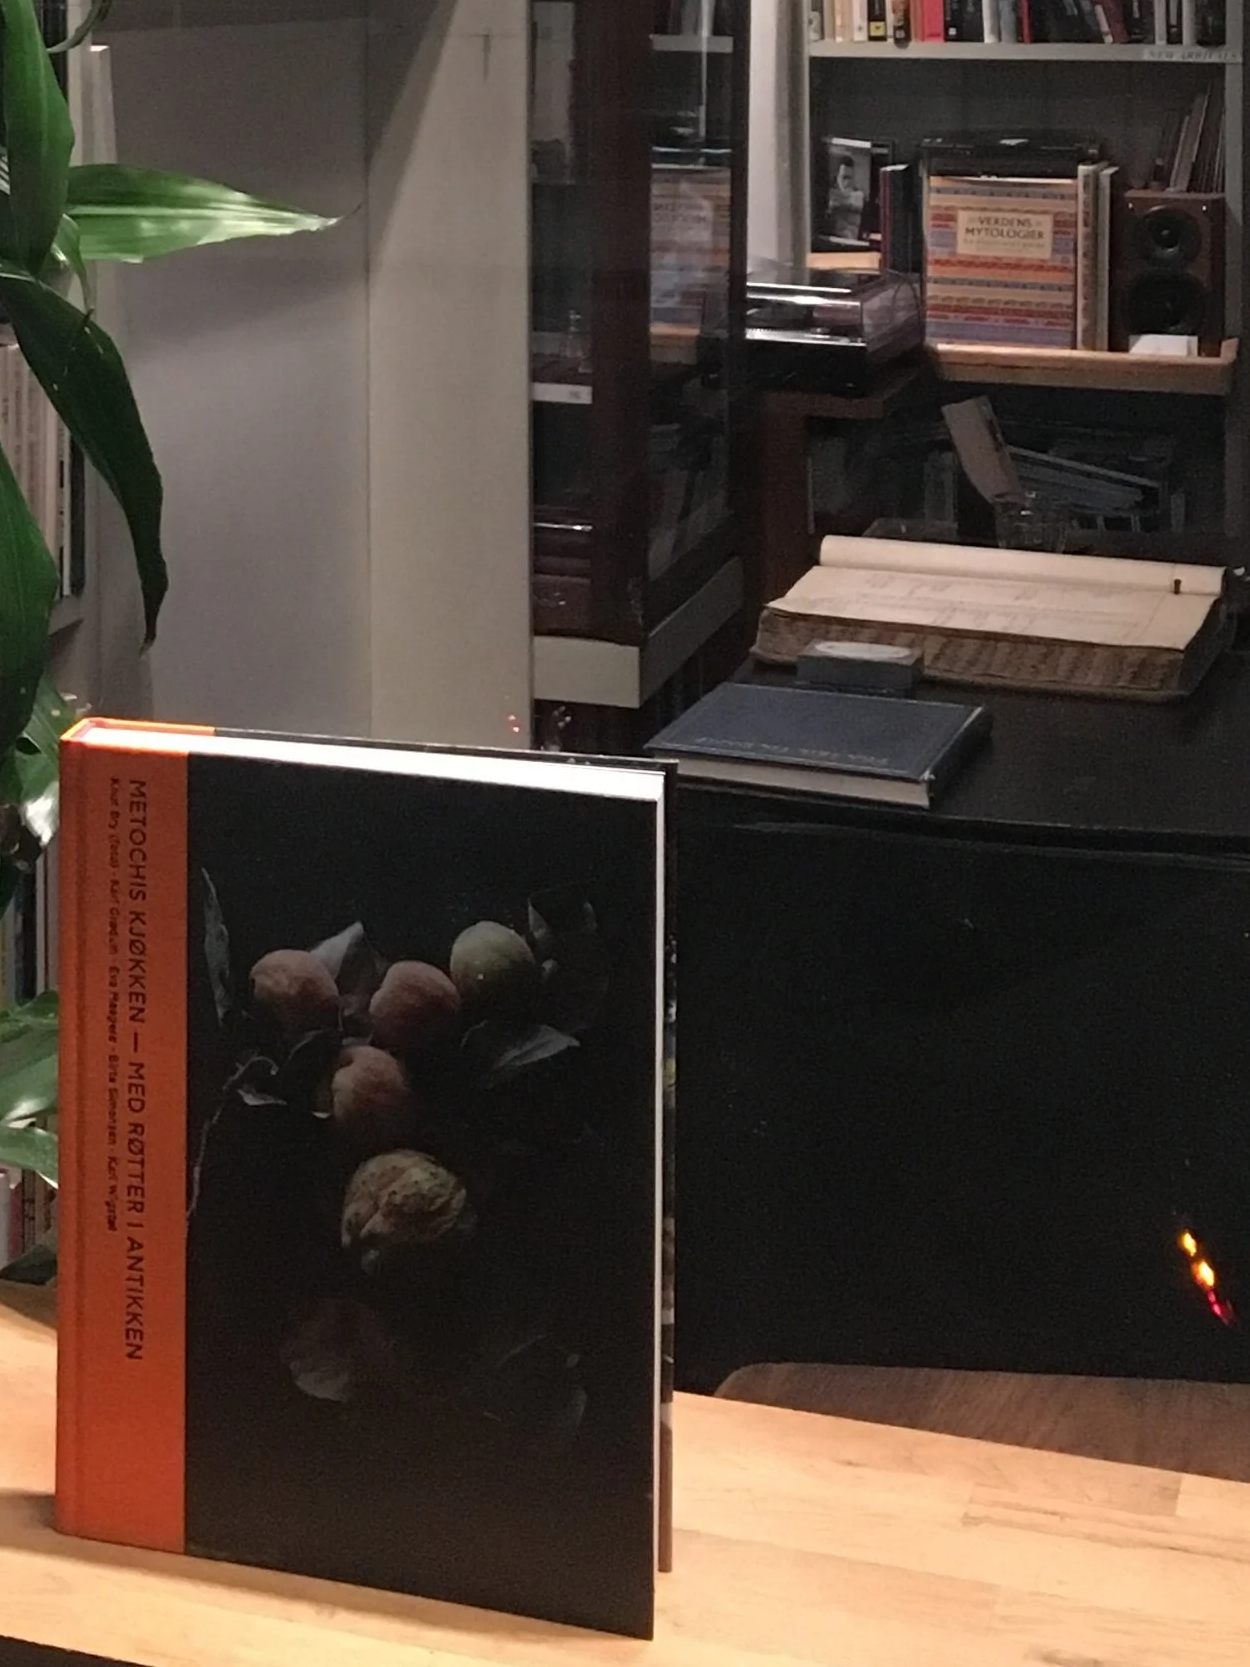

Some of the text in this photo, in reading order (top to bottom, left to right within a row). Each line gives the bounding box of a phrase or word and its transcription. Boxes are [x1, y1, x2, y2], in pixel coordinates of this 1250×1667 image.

[965, 227, 1045, 240] MYTOLOGIER
[978, 216, 1033, 228] VERDENS
[128, 779, 147, 901] METOCHIS
[128, 910, 146, 1024] KJØKKEN
[127, 1062, 146, 1114] MED
[126, 1122, 146, 1214] RØTTER
[124, 1235, 145, 1361] ANTIKKEN
